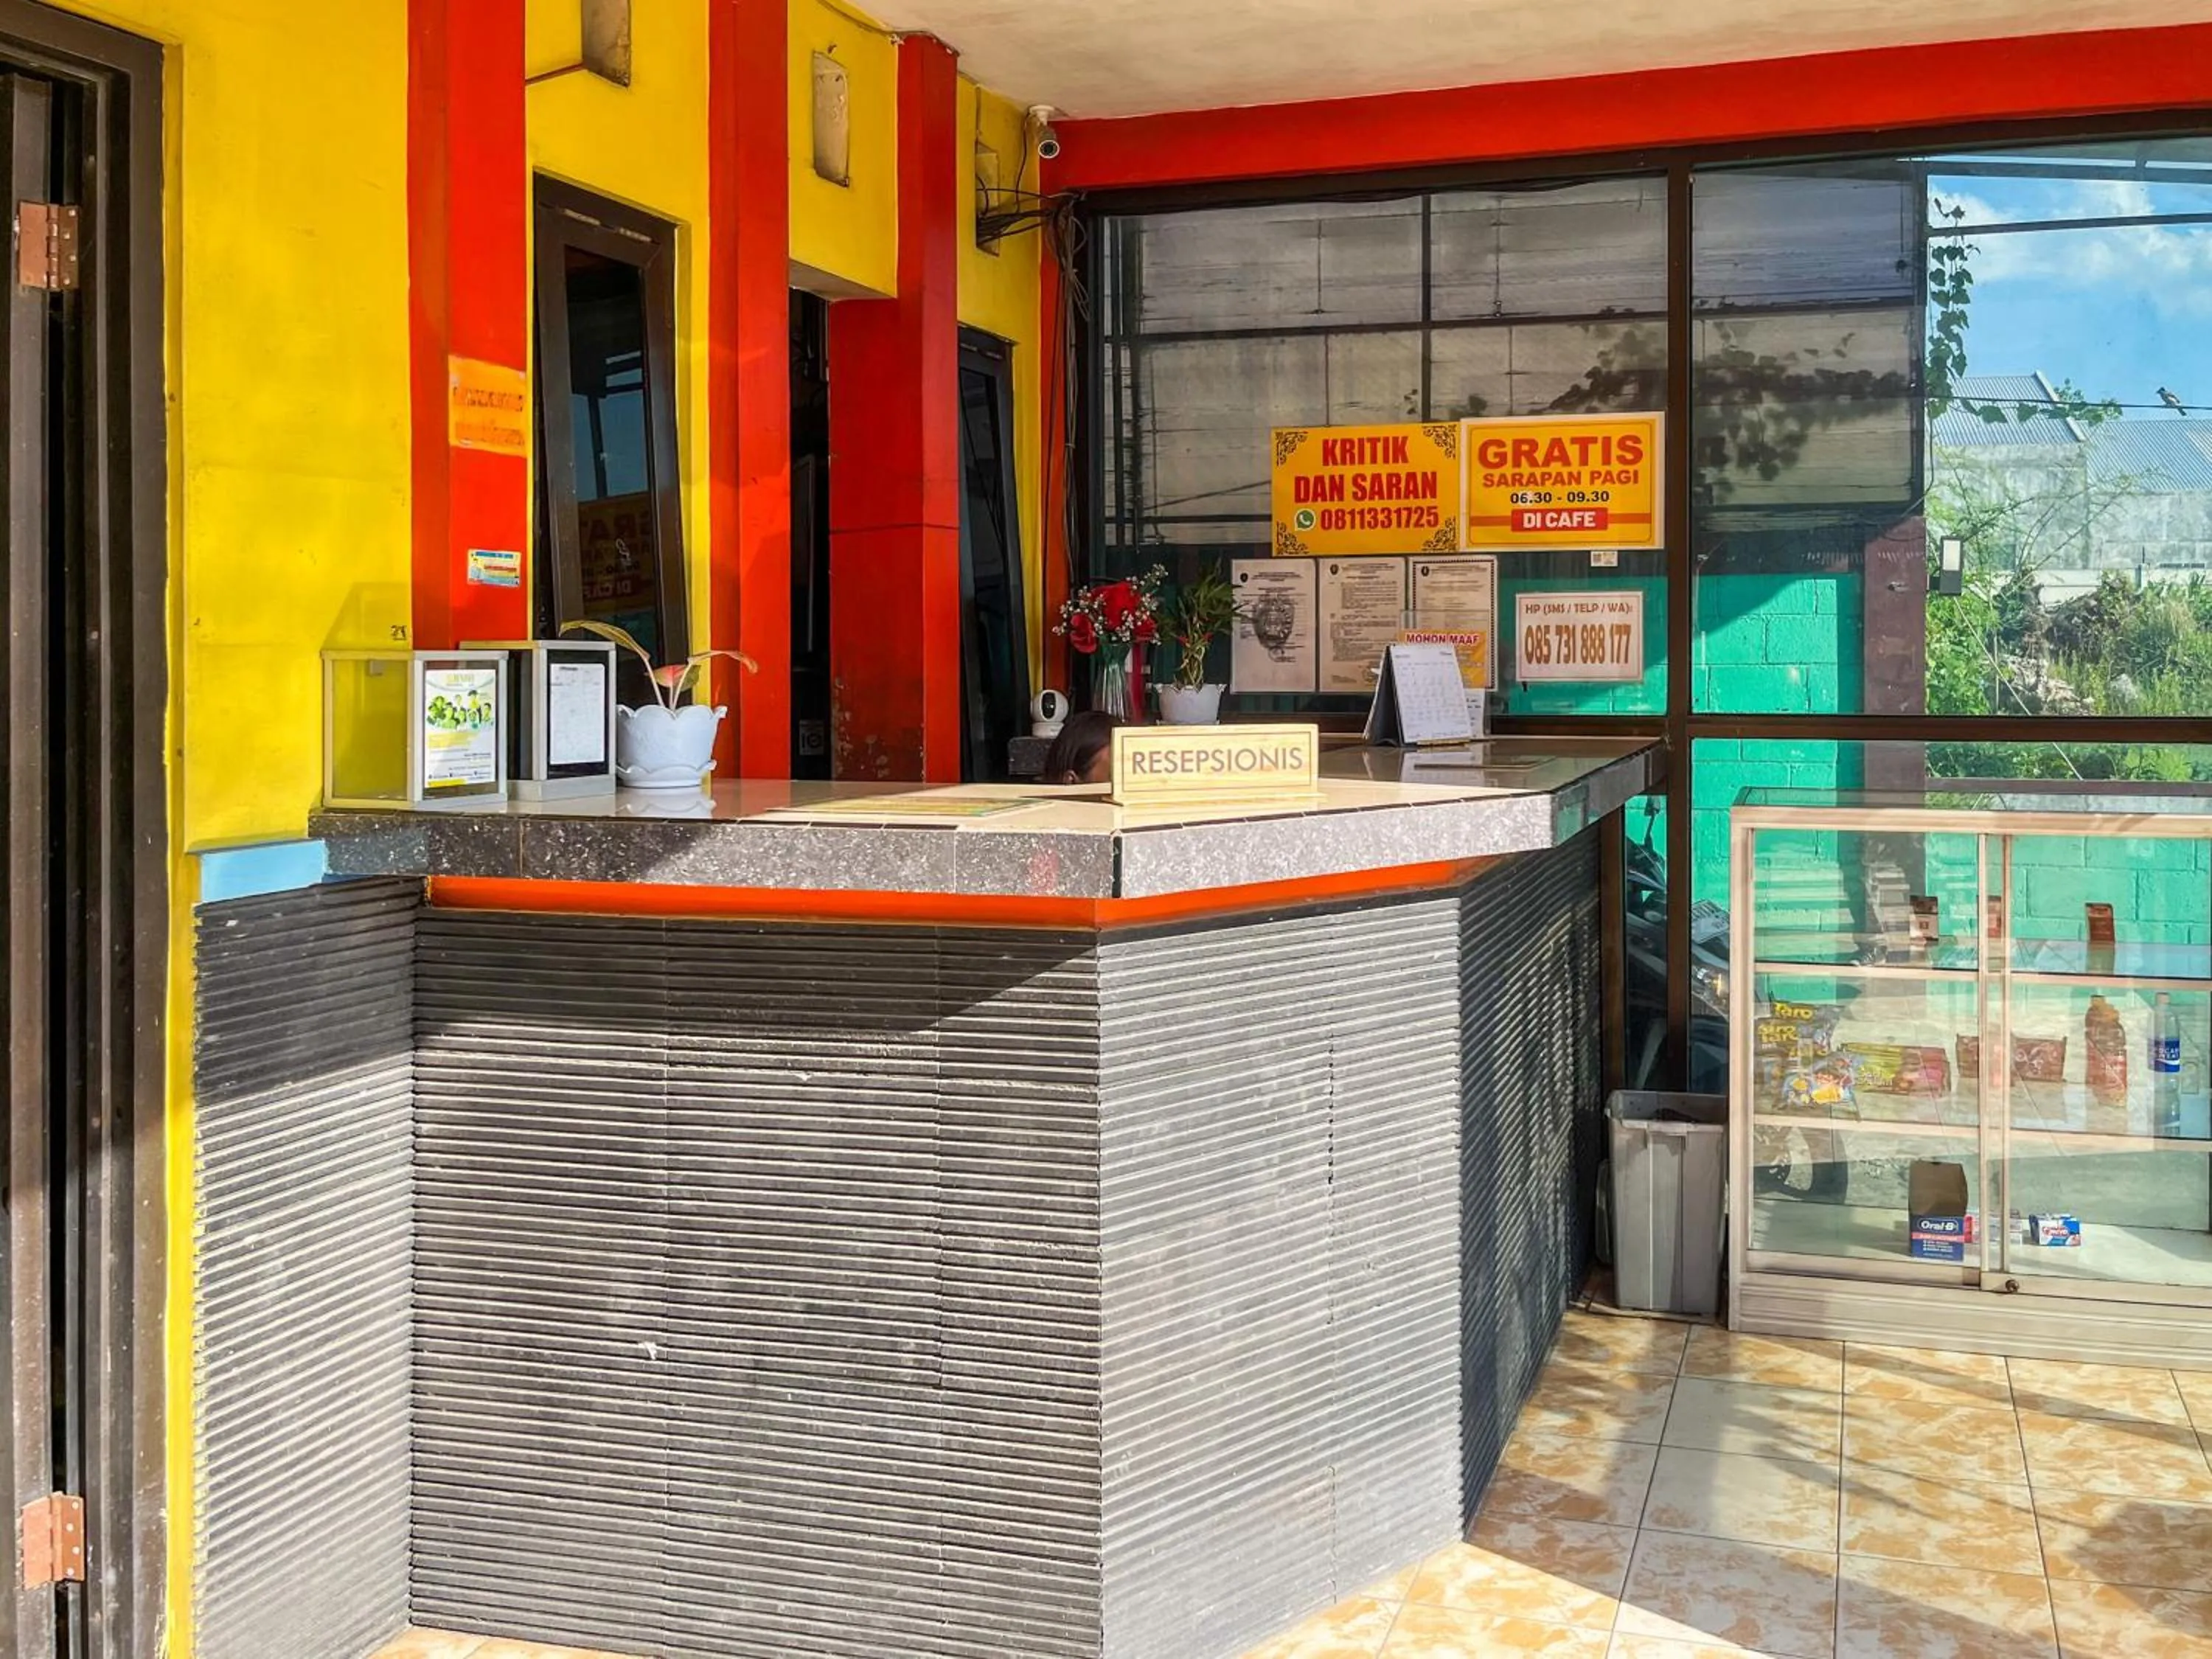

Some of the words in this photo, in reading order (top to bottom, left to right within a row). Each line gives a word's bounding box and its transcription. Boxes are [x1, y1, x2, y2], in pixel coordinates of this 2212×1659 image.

[1322, 436, 1409, 467] KRITIK
[1478, 435, 1644, 470] GRATIS
[1294, 474, 1344, 504] DAN
[1352, 471, 1437, 501] SARAN
[1483, 471, 1582, 488] SARAPAN
[1589, 470, 1638, 485] PAGI
[1510, 491, 1552, 504] 06.30
[1567, 490, 1610, 503] 09.30
[1321, 506, 1439, 531] 0811331725
[1523, 512, 1541, 529] DI
[1545, 511, 1596, 528] CAFE
[1526, 604, 1540, 614] HP
[1574, 603, 1599, 613] TELP
[1406, 634, 1446, 644] MOHON
[1450, 635, 1479, 644] MAAF
[1525, 625, 1551, 664] 085
[1555, 625, 1576, 664] 731
[1581, 624, 1605, 664] 888
[1610, 624, 1632, 664] 177
[1131, 747, 1303, 775] RESEPSIONIS
[1775, 1004, 1812, 1019] Taro
[1921, 1220, 1954, 1231] Oral-B
